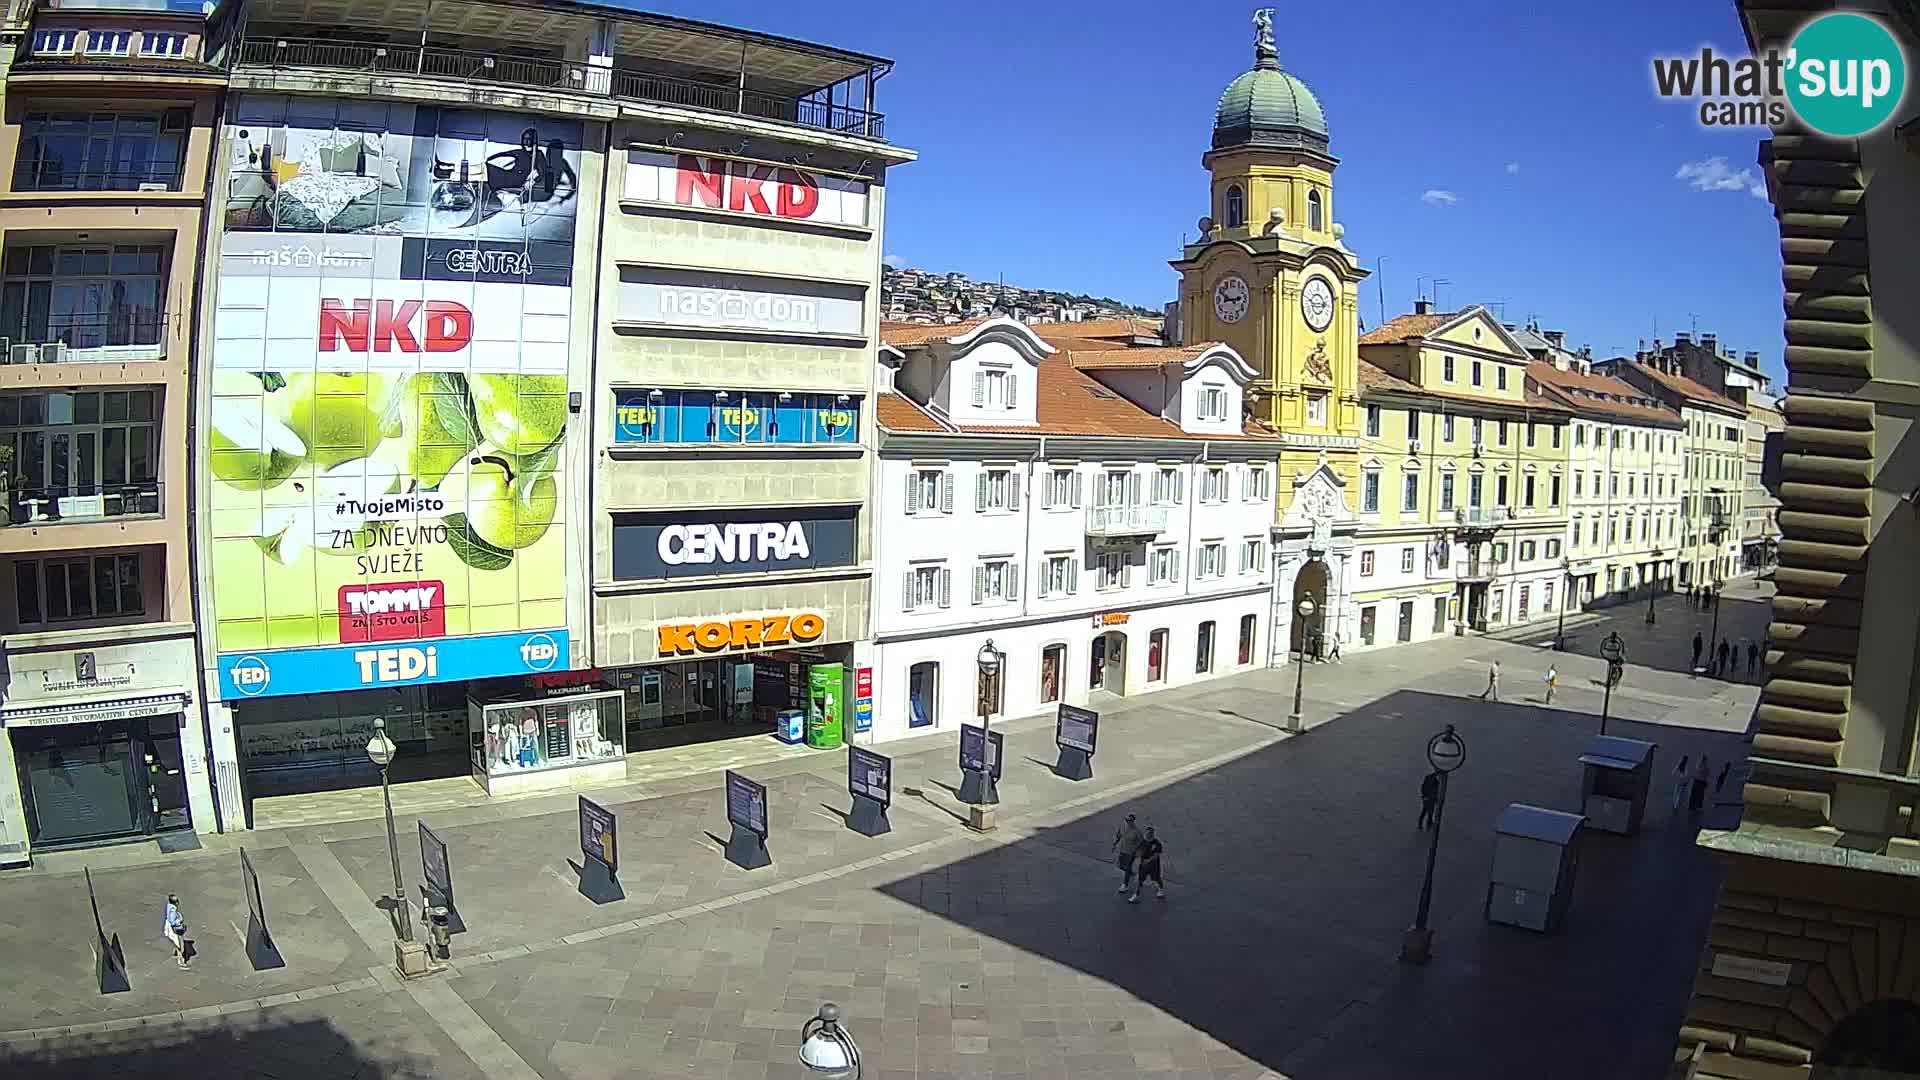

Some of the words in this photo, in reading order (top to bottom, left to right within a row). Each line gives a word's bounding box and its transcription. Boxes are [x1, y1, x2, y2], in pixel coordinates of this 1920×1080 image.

[675, 153, 819, 219] NKD
[446, 248, 534, 275] CENTRA
[319, 297, 474, 353] NKD
[335, 497, 444, 517] #TvojeMisto
[331, 529, 356, 550] ZA
[364, 524, 449, 548] DNEVNO
[657, 520, 810, 565] CENTRA
[356, 548, 424, 576] SVJEŽE
[345, 586, 437, 616] TOMMY
[658, 613, 825, 658] KORZO
[354, 646, 438, 684] TEDi
[520, 642, 557, 661] TEDi
[230, 666, 270, 685] TEDi
